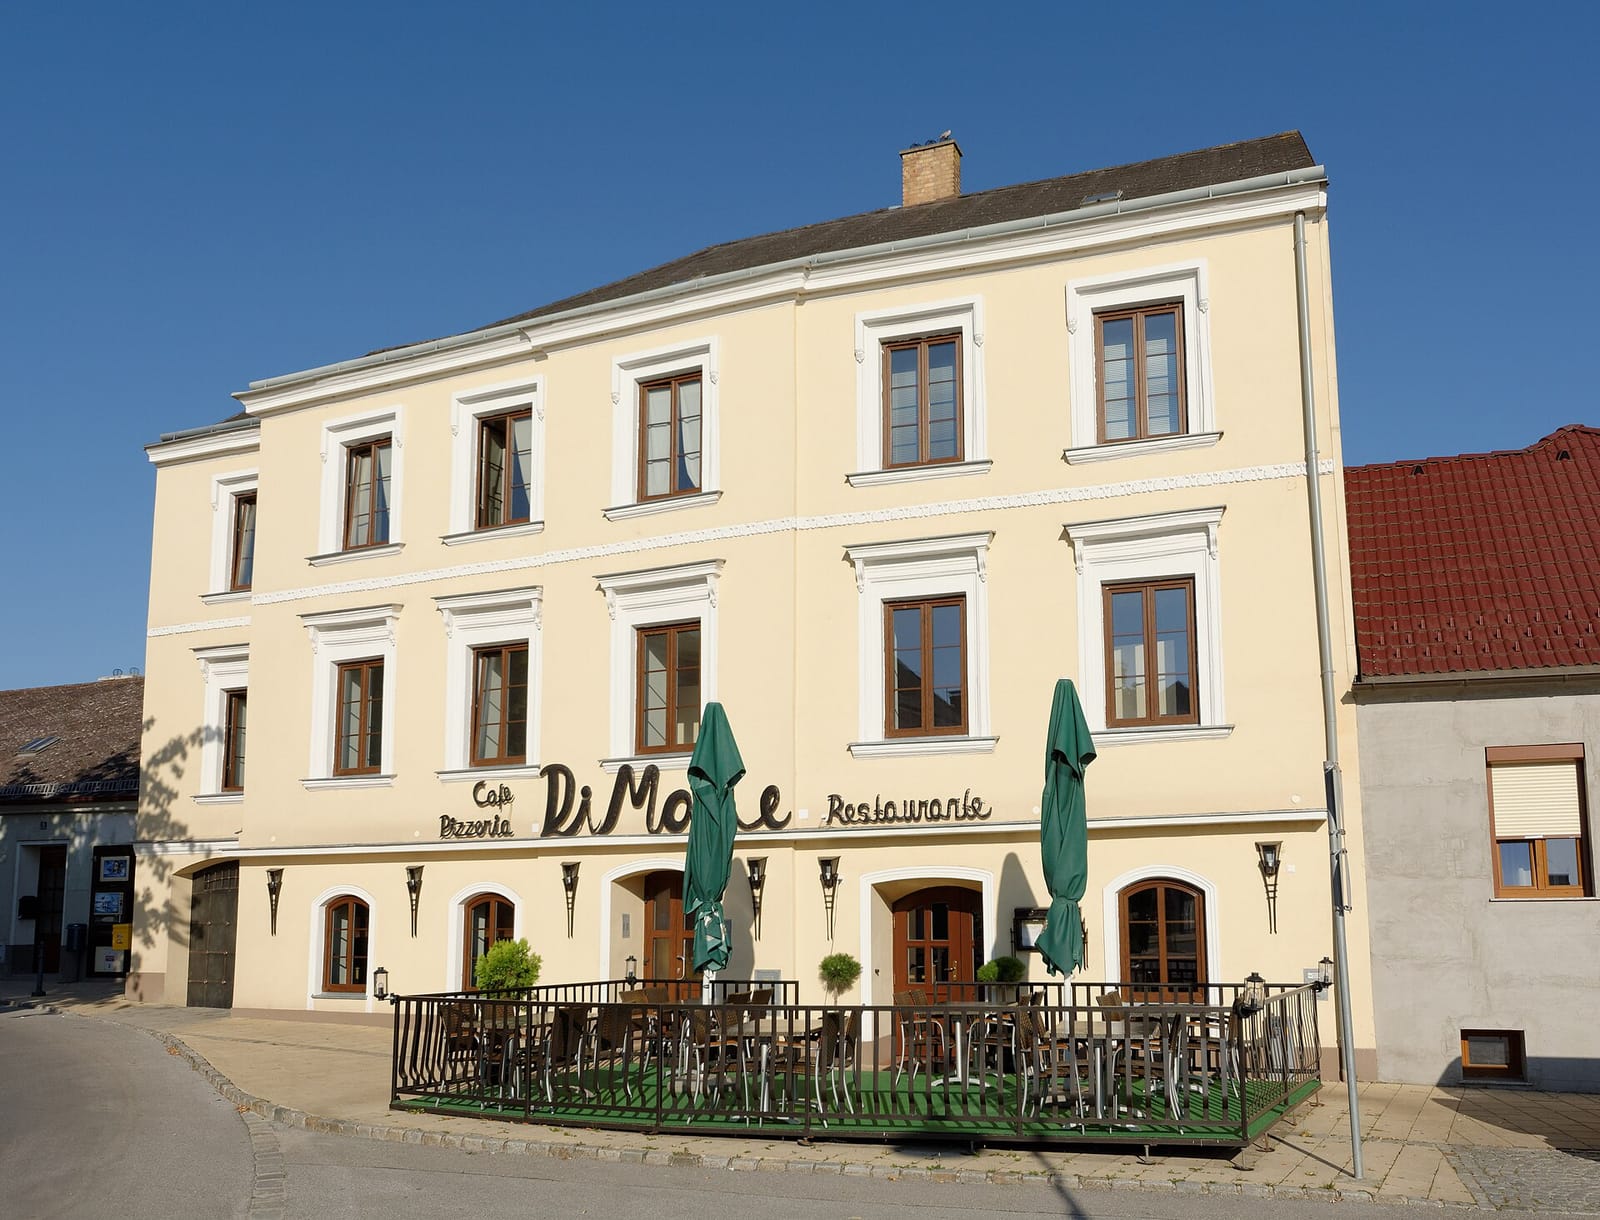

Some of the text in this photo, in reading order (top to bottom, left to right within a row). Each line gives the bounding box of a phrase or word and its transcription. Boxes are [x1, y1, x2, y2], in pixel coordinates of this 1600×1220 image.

[597, 764, 792, 835] Mae
[826, 788, 992, 825] Restaurante
[439, 814, 514, 839] Pizzeria
